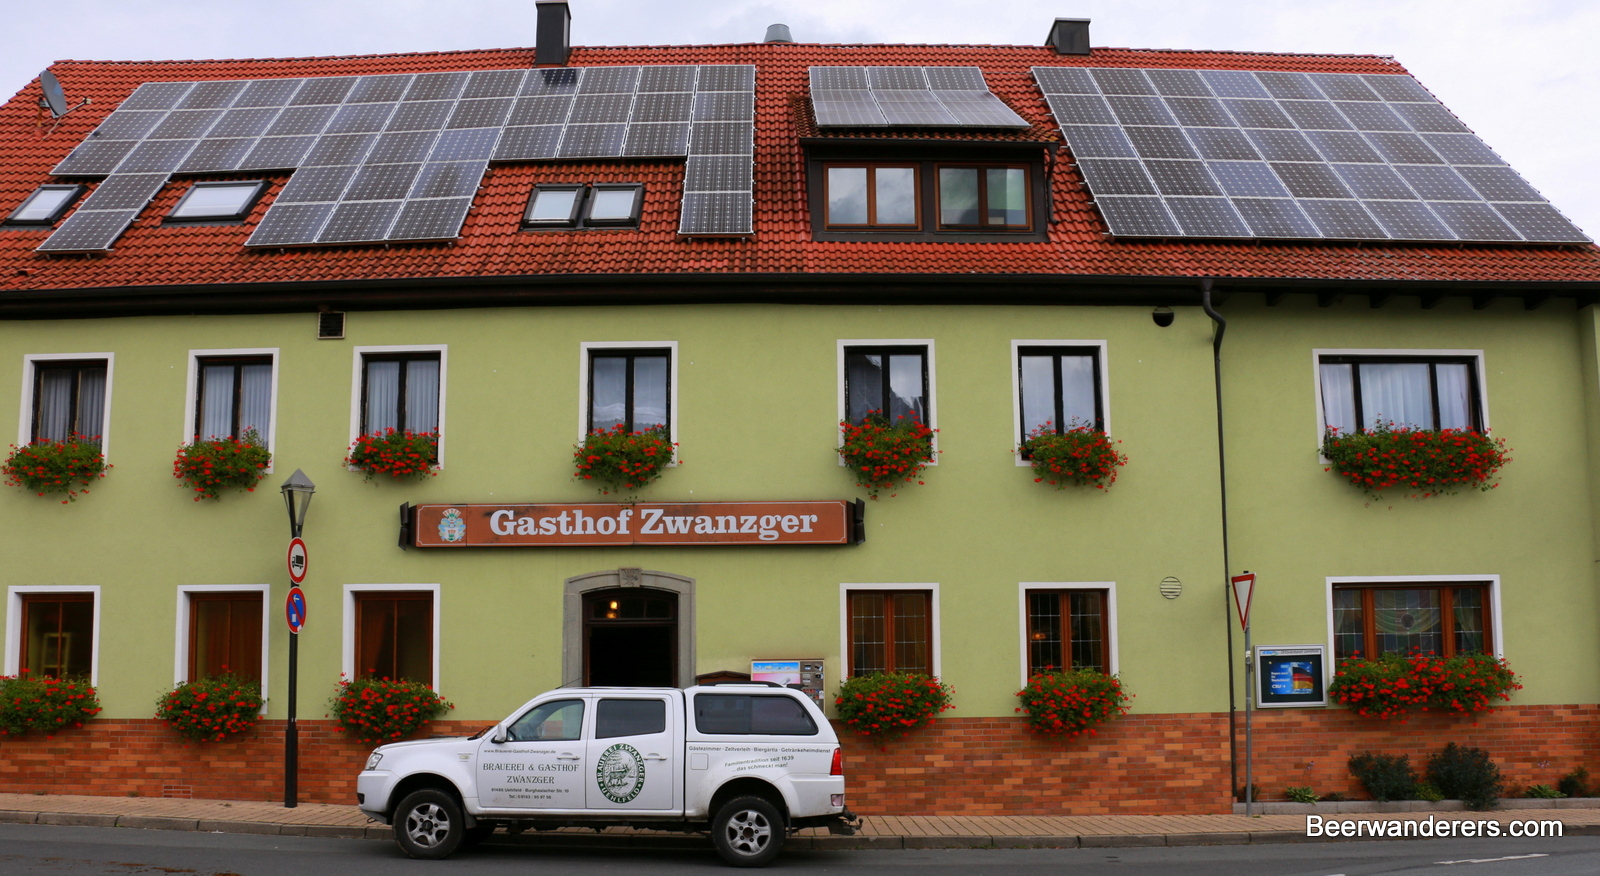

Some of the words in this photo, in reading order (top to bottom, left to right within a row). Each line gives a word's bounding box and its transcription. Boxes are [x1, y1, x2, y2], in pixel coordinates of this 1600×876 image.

[489, 509, 633, 535] Gasthof
[640, 508, 818, 541] Zwanzger
[724, 758, 769, 767] Familientradition
[483, 763, 525, 771] BRAUEREI
[528, 763, 535, 771] &
[537, 763, 580, 772] GASTHOF
[506, 775, 555, 784] ZWANZGER
